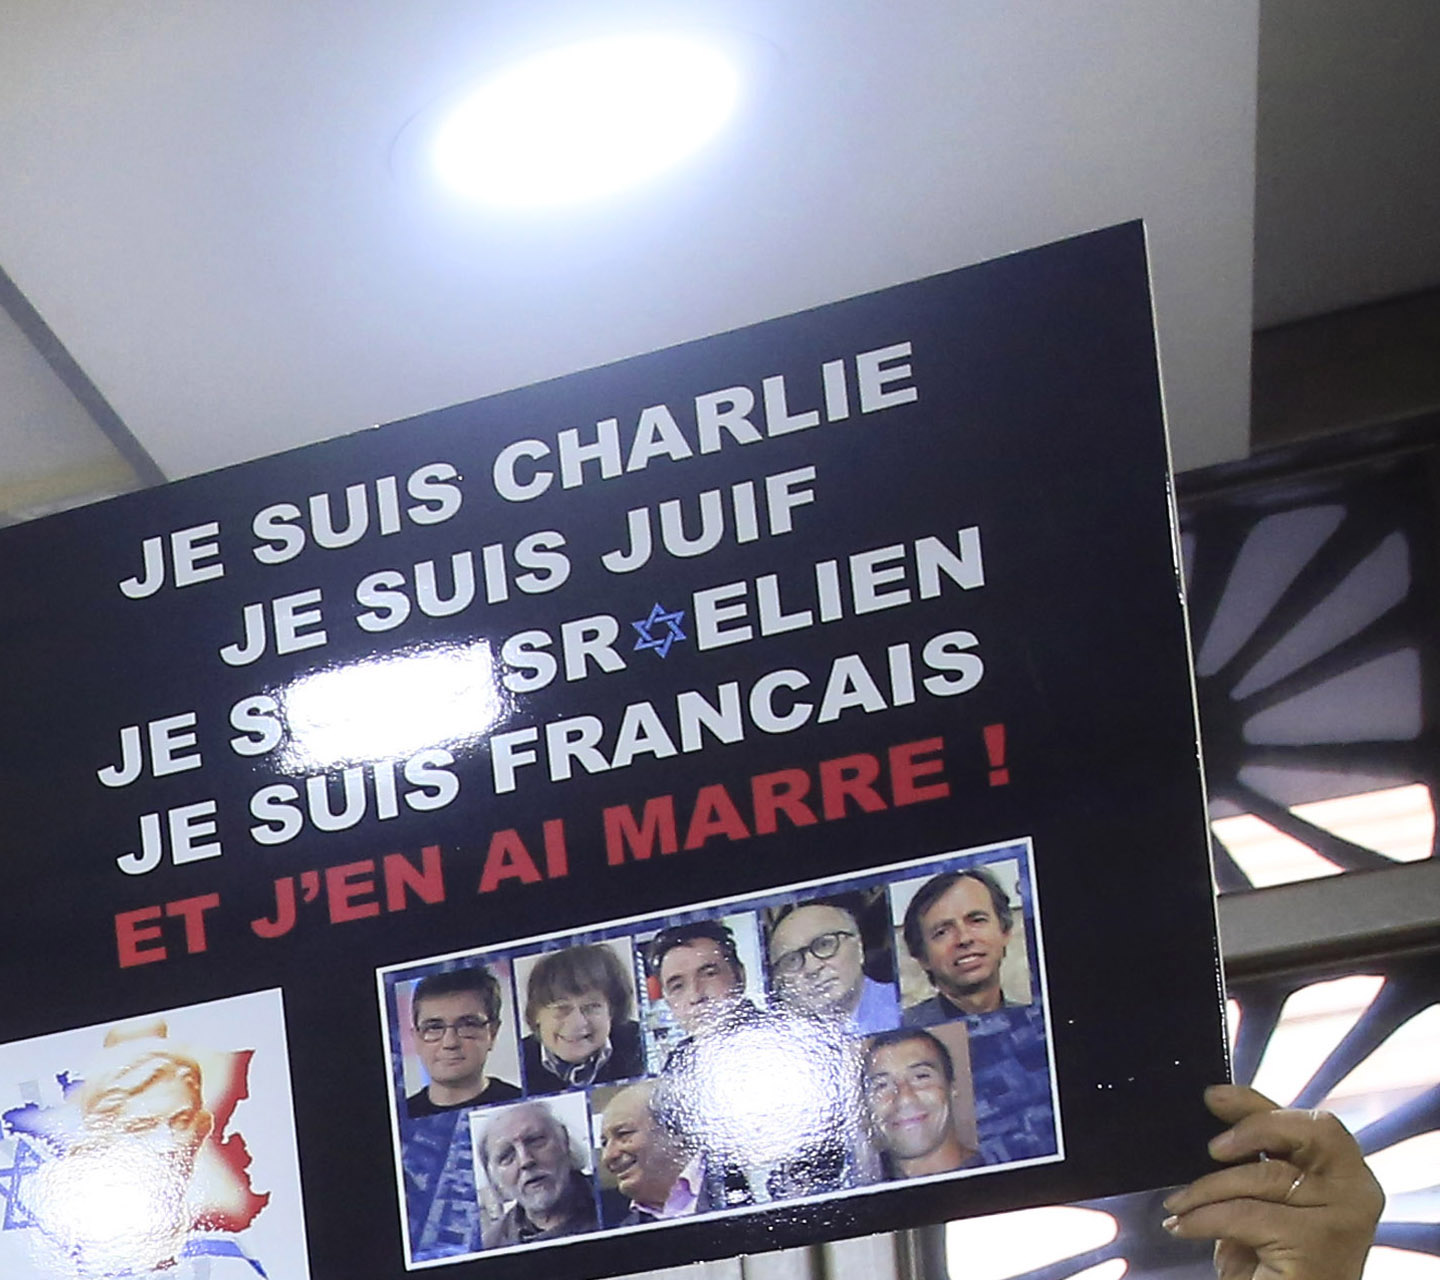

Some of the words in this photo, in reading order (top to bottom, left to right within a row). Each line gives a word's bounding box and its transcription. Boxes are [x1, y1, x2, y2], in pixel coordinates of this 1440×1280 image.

[120, 522, 224, 598] JE
[254, 464, 462, 563] SUIS
[494, 342, 917, 500] CHARLIE
[220, 589, 326, 664] JE
[356, 532, 570, 631] SUIS
[602, 466, 816, 572] JUIF
[97, 711, 202, 787] JE
[116, 800, 222, 875] JE
[249, 750, 460, 845] SUIS
[490, 632, 985, 794] FRANCAIS
[116, 894, 219, 967] ET
[480, 820, 567, 892] AI
[604, 738, 948, 864] MARRE
